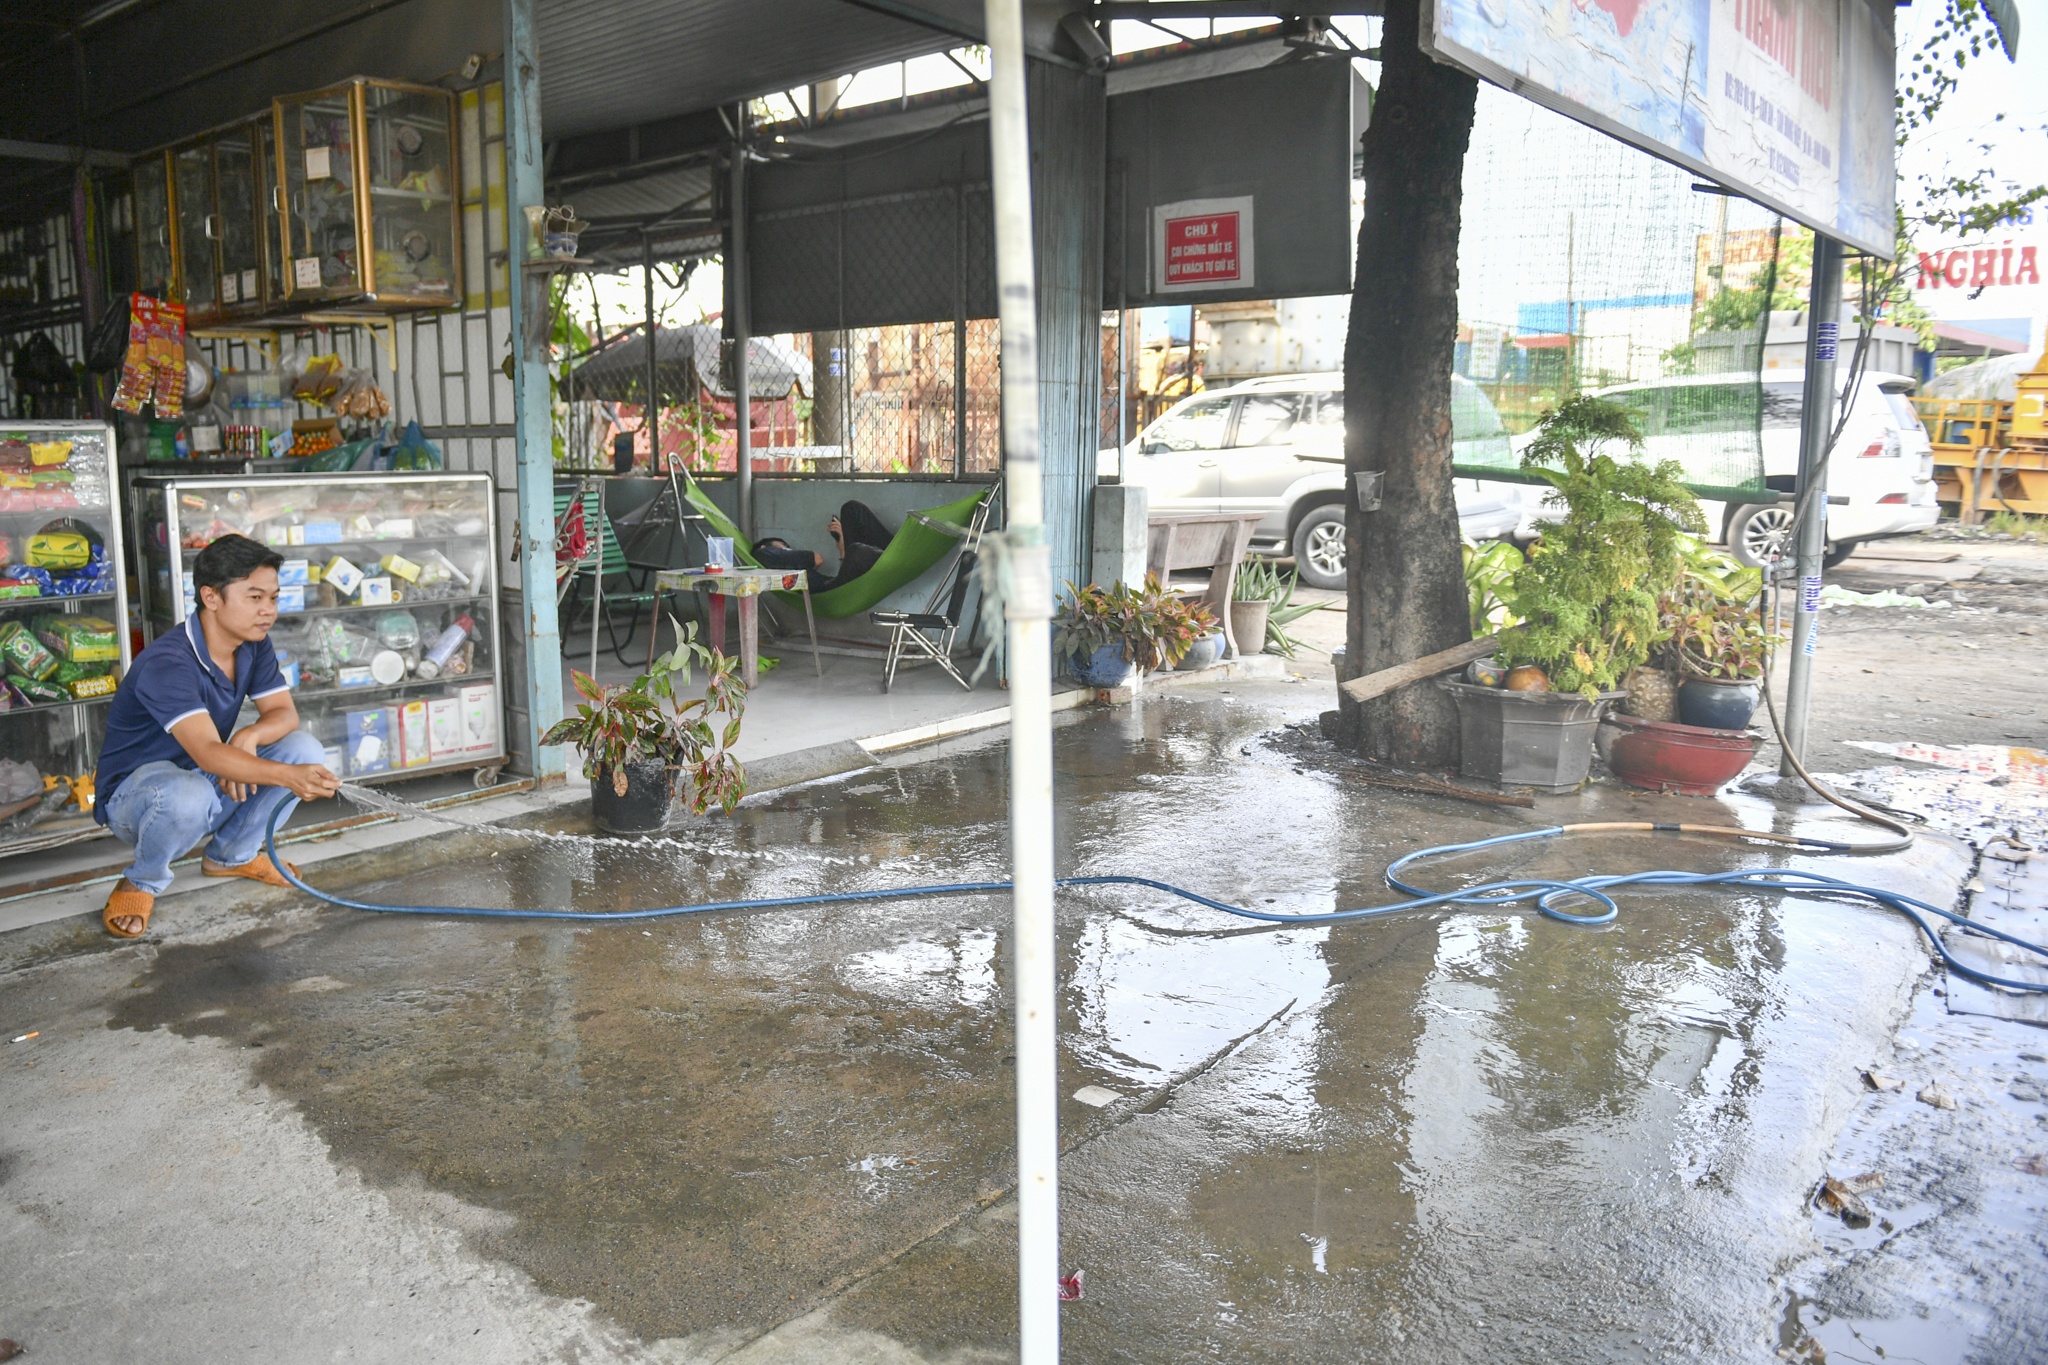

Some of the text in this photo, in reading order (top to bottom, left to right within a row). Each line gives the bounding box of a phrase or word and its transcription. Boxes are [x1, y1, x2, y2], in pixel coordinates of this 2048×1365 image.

[1186, 221, 1218, 236] CHÚ Ý
[1225, 242, 1232, 253] XE
[1227, 259, 1235, 270] XE
